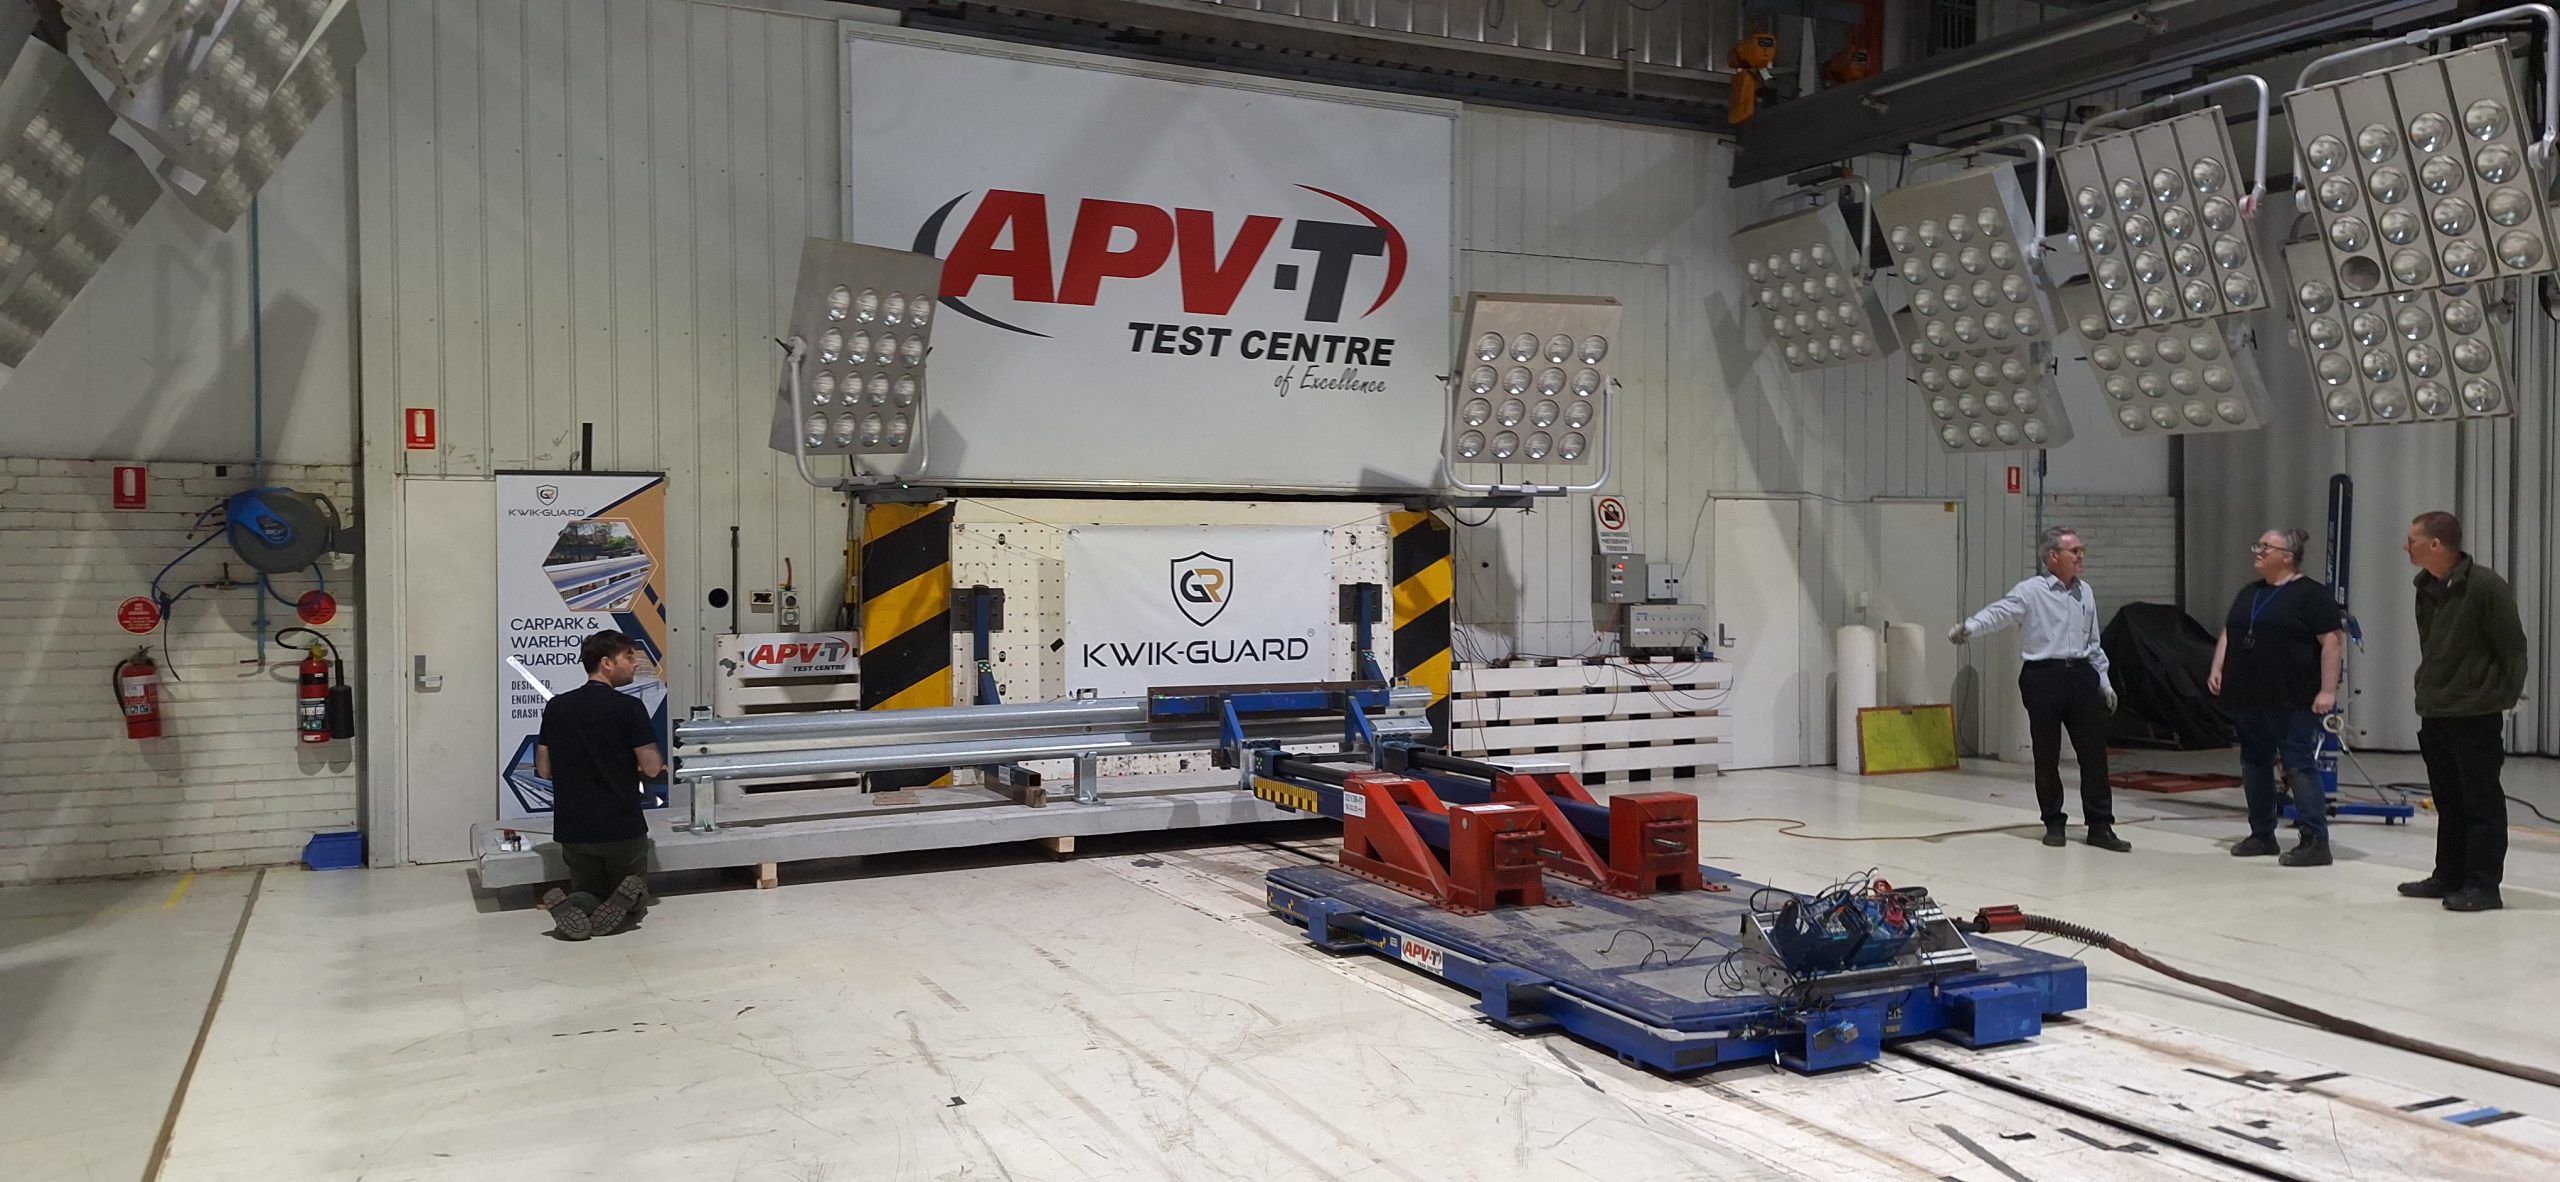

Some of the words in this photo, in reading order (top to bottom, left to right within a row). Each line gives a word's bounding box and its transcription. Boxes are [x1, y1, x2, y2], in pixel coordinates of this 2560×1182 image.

[1128, 322, 1233, 357] TEST
[1240, 329, 1396, 367] CENTRE
[1273, 364, 1294, 398] of
[1299, 364, 1387, 393] Excellence
[508, 508, 586, 517] KWIK-GUARD
[510, 617, 585, 631] CARPARK
[586, 617, 600, 630] &
[1083, 637, 1309, 668] KWIK-GUARD
[792, 665, 814, 673] TEST
[814, 664, 846, 672] CENTRE
[511, 694, 546, 705] ENGINEE
[511, 708, 538, 719] CRASH
